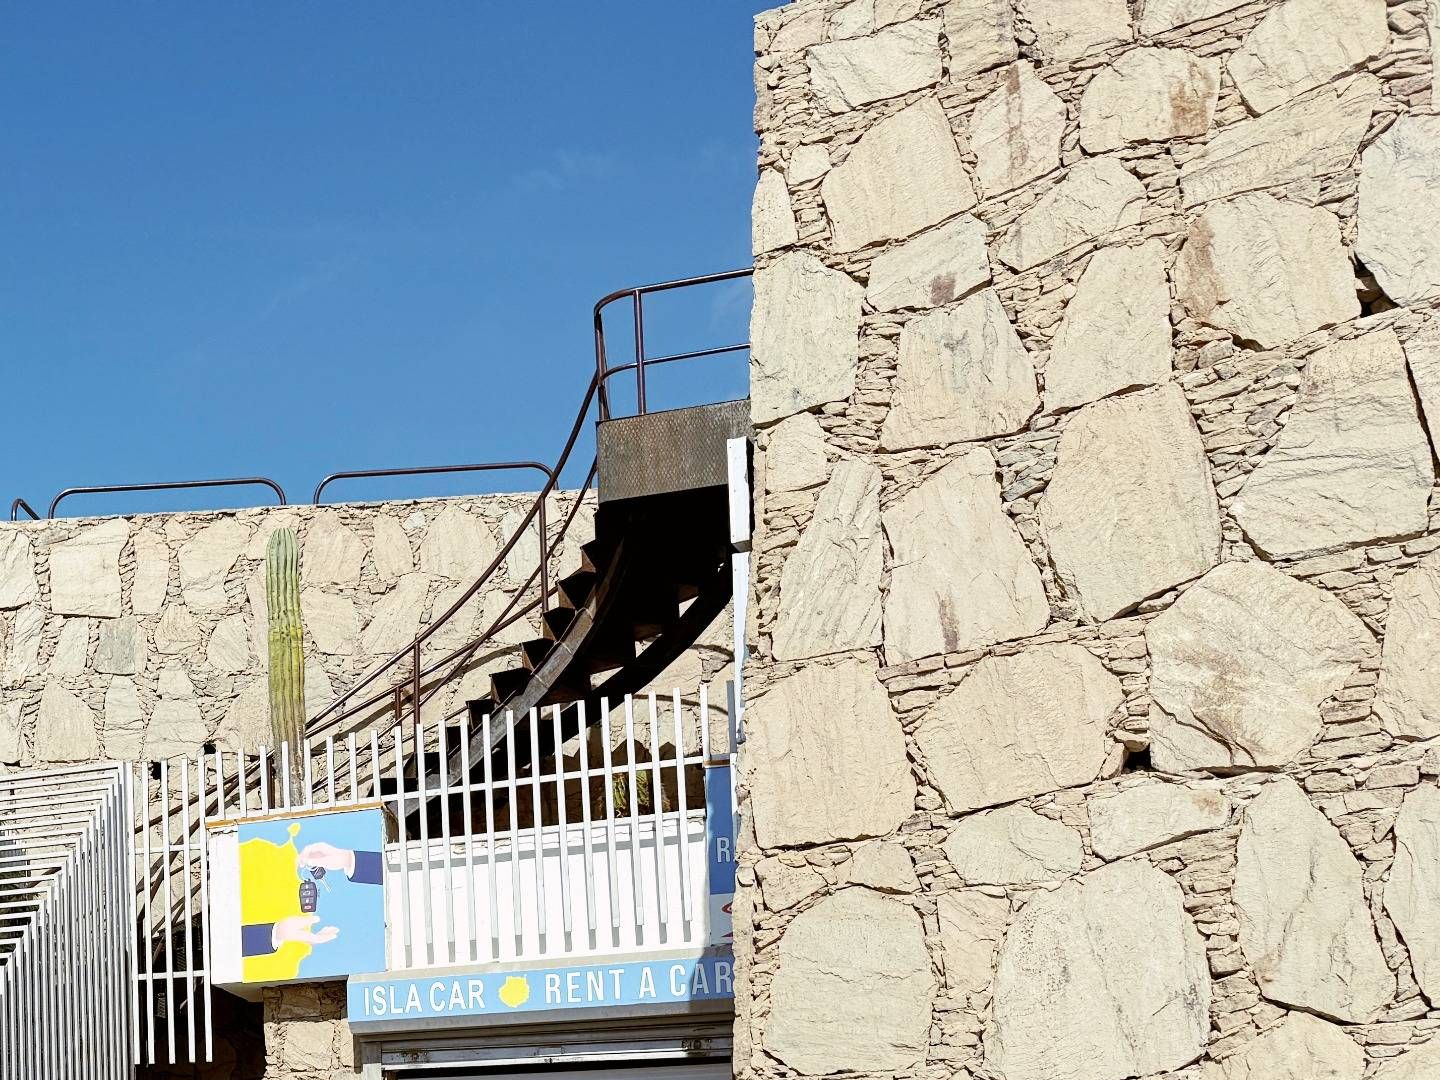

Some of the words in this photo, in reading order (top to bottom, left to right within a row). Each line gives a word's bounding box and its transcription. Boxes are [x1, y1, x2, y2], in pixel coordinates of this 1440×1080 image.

[364, 983, 423, 1016] ISLA
[429, 979, 486, 1012] CAR
[544, 968, 625, 1004] RENT
[639, 966, 657, 999] A
[669, 961, 732, 997] CAR
